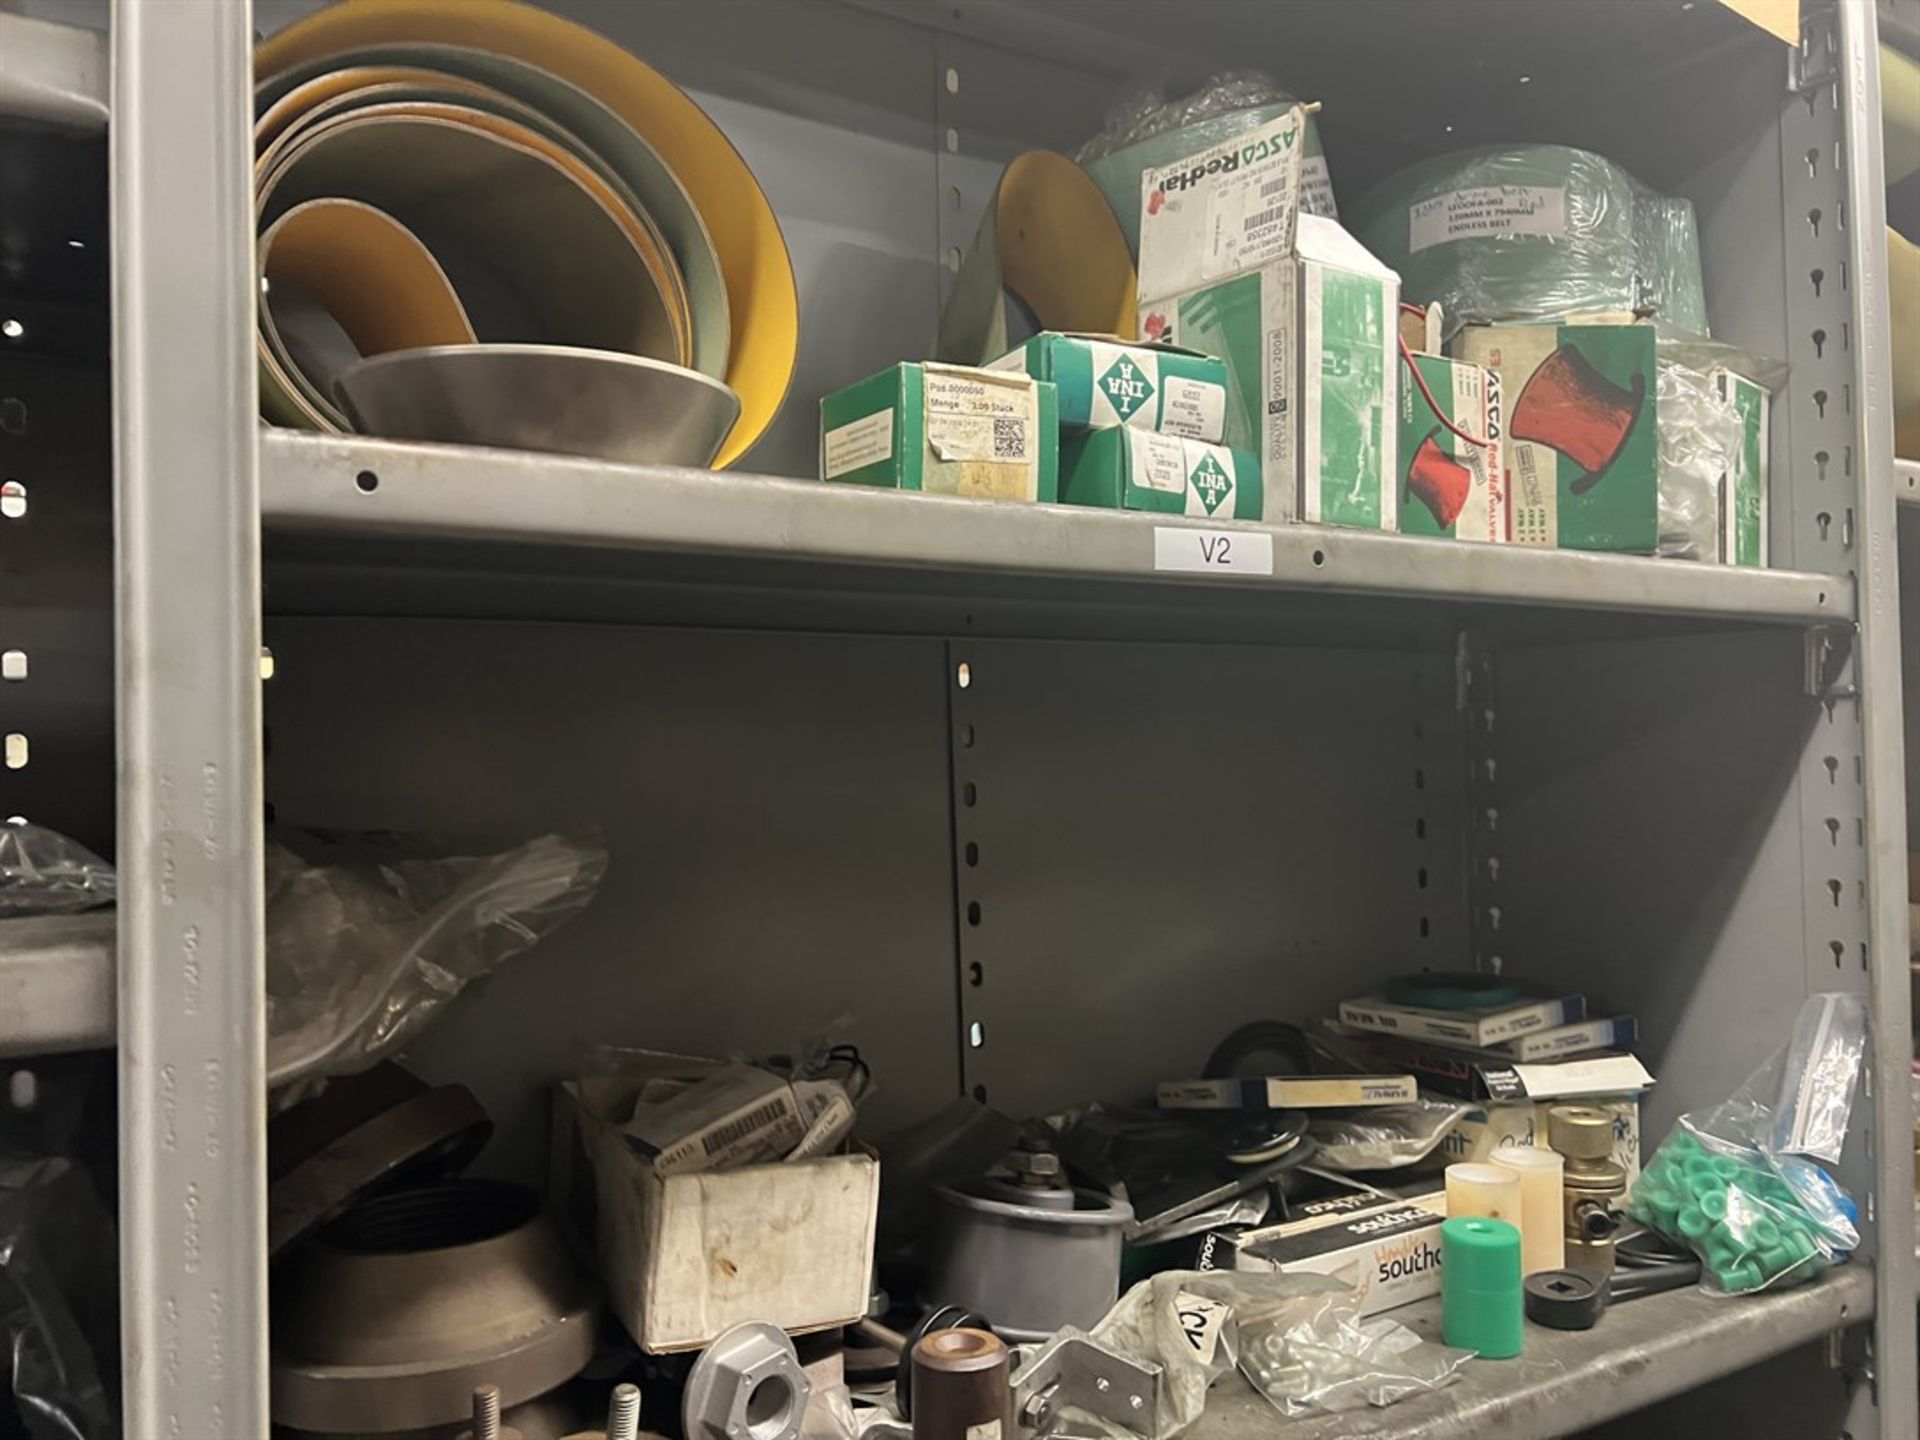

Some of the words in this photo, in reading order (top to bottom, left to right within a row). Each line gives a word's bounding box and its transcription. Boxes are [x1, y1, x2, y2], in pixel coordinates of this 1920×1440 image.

[1242, 127, 1296, 165] ASCO
[1448, 221, 1487, 234] ENDLESS
[1489, 219, 1511, 228] BELT
[1107, 376, 1145, 398] INA
[930, 398, 960, 410] Menge
[1487, 368, 1499, 440] ASCO
[1197, 471, 1227, 492] INA
[1488, 443, 1499, 496] Red-Hat
[1200, 536, 1231, 564] V2
